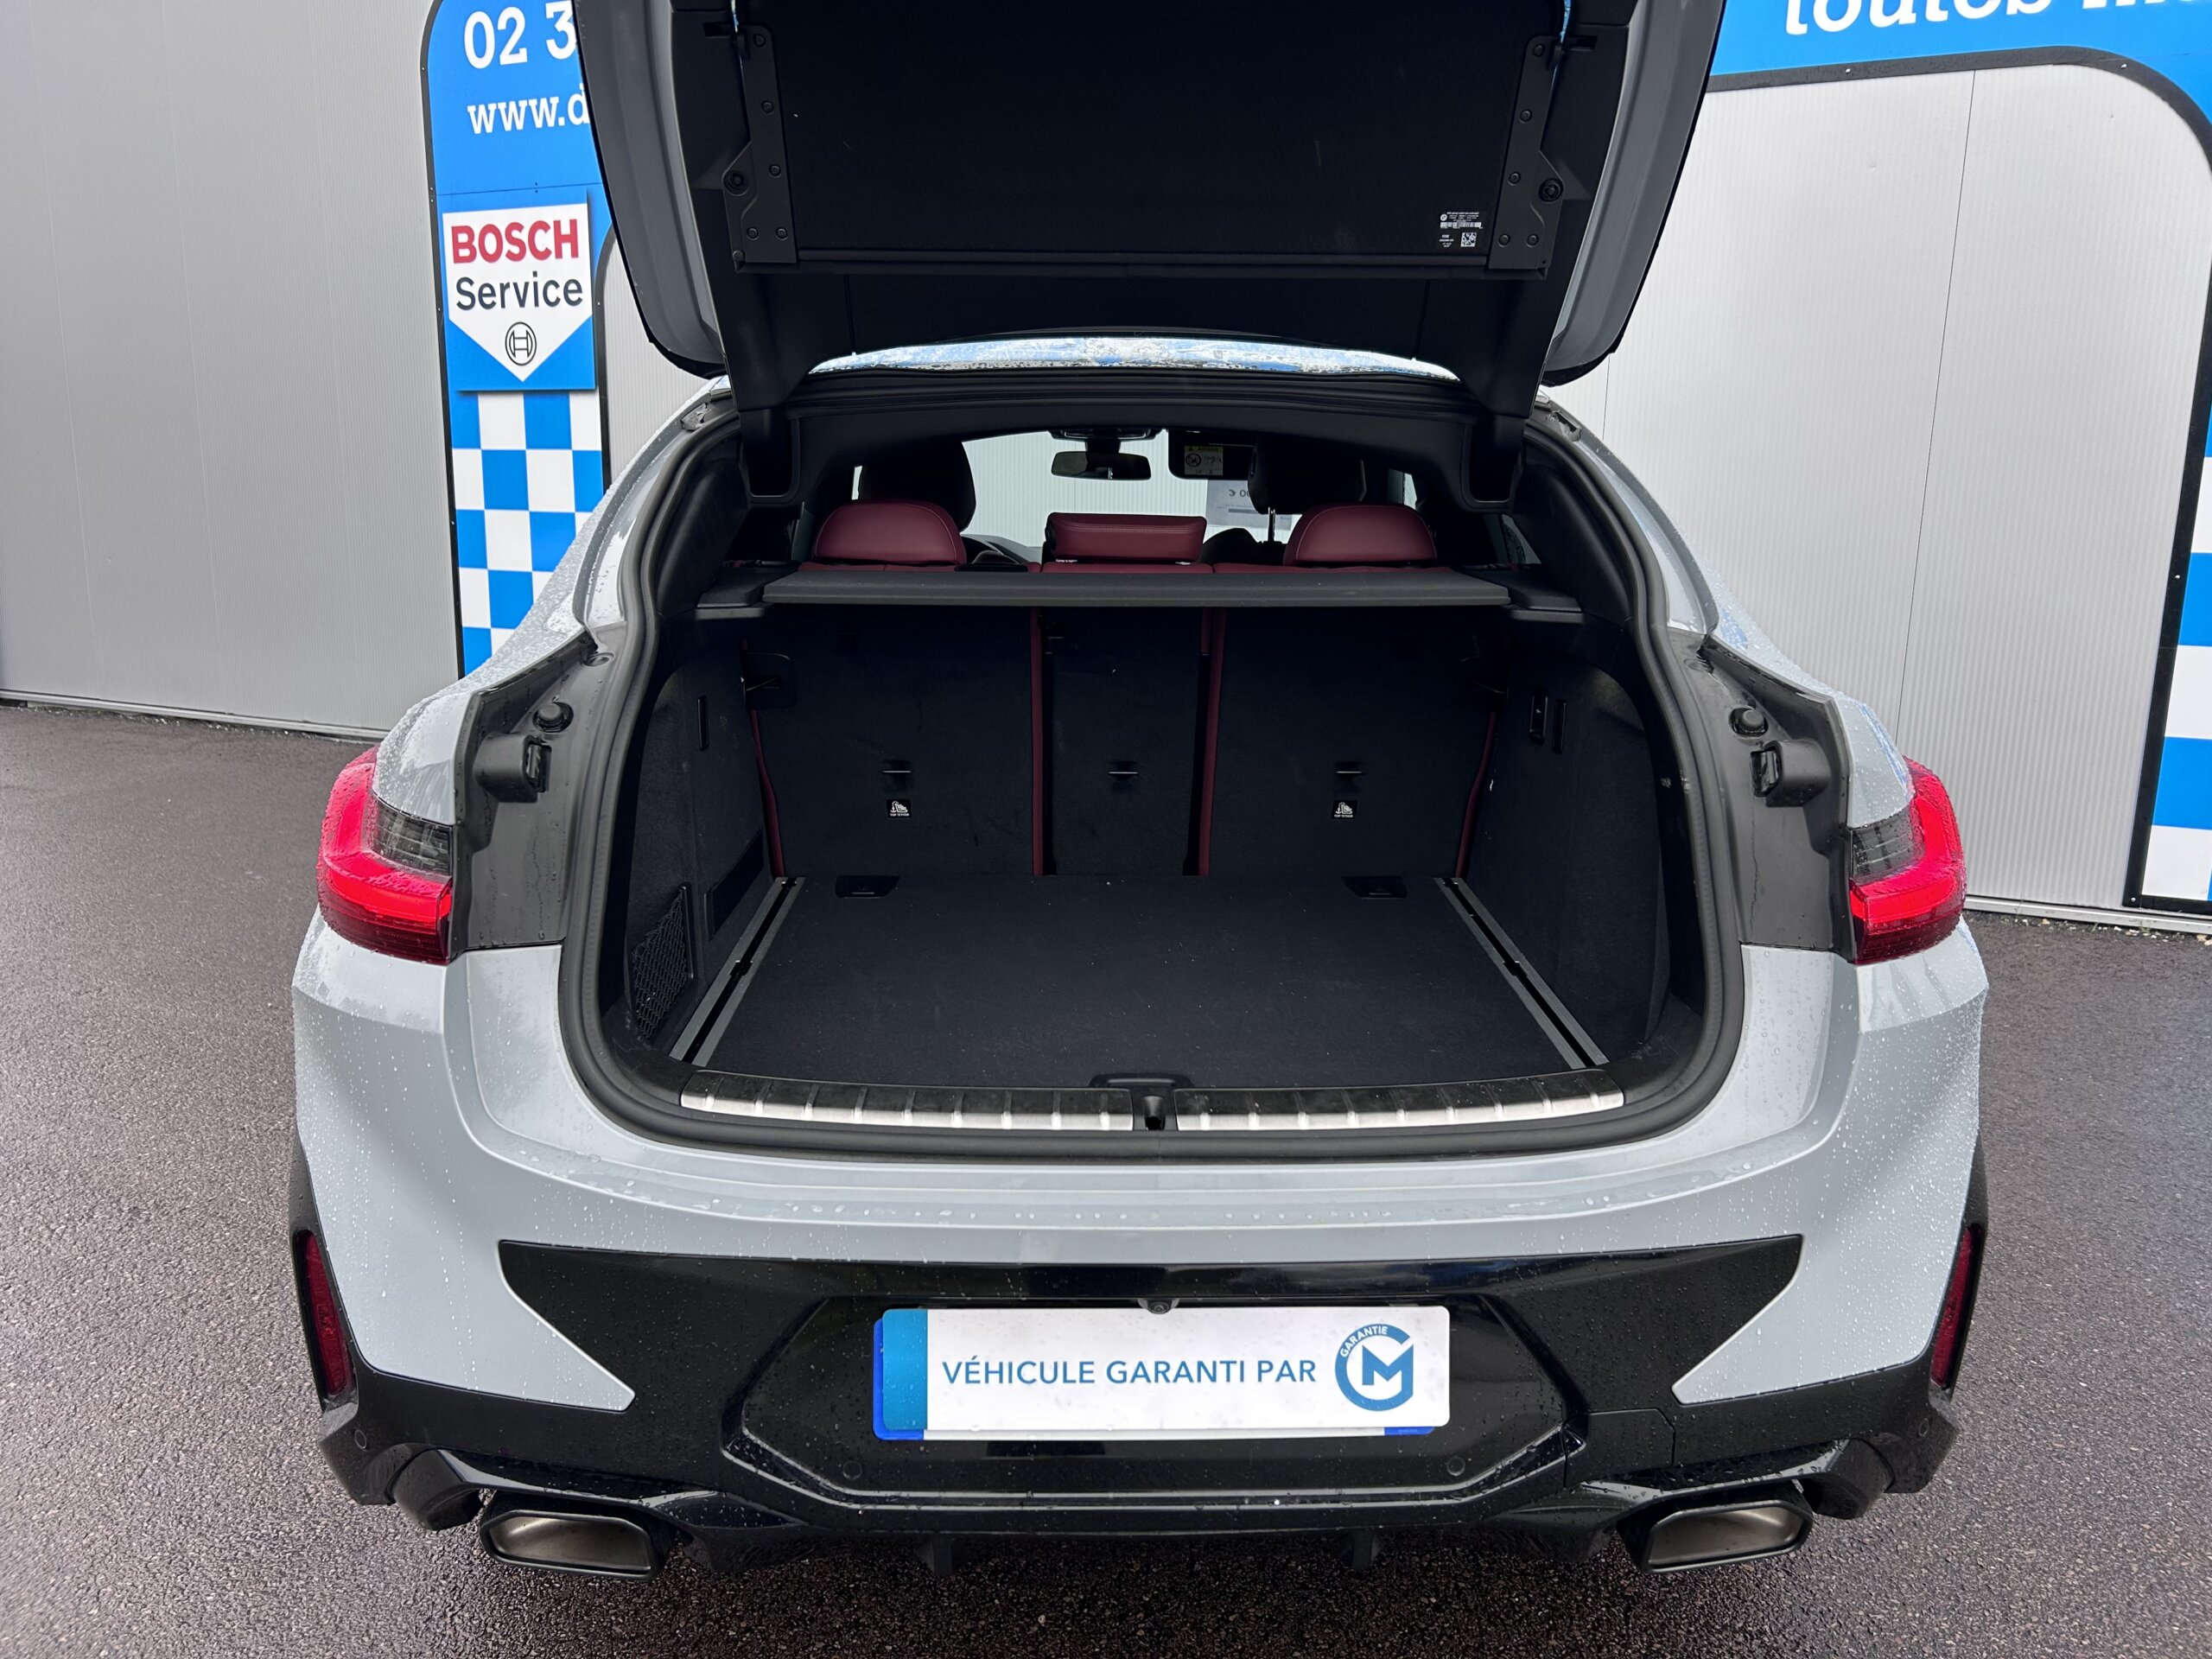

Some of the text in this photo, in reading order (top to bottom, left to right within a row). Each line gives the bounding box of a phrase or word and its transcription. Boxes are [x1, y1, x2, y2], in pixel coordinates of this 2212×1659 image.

[464, 7, 528, 69] 02
[451, 219, 579, 264] BOSCH
[455, 270, 583, 311] Service
[1339, 1325, 1389, 1357] GARANTIE
[942, 1354, 1316, 1385] VÉHICULE GARANTI PAR
